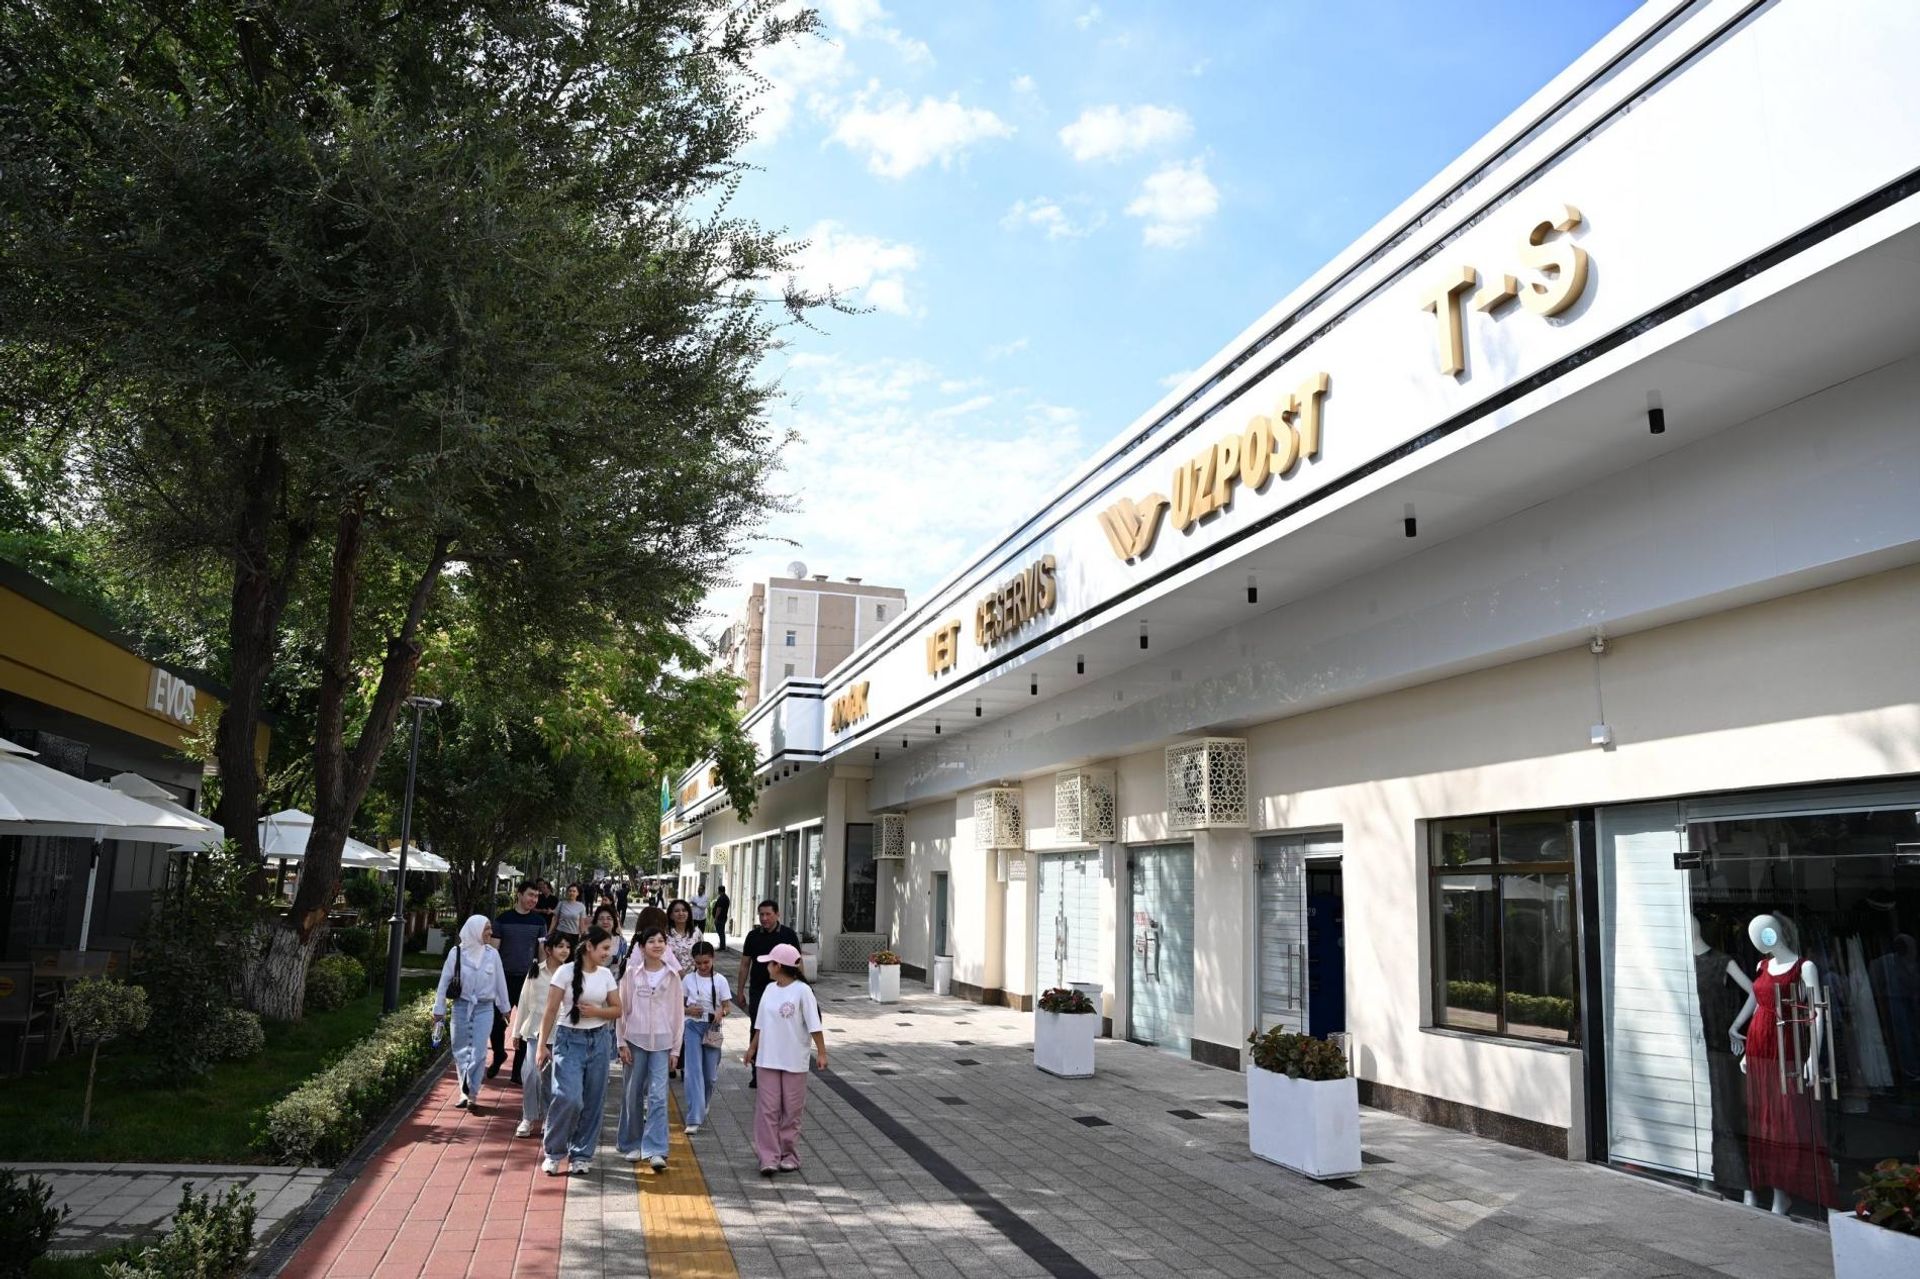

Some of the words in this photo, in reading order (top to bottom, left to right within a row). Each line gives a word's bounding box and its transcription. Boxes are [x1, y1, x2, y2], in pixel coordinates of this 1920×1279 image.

[1171, 372, 1329, 531] UZPOST
[926, 619, 961, 676] VET
[148, 667, 196, 726] EVOS
